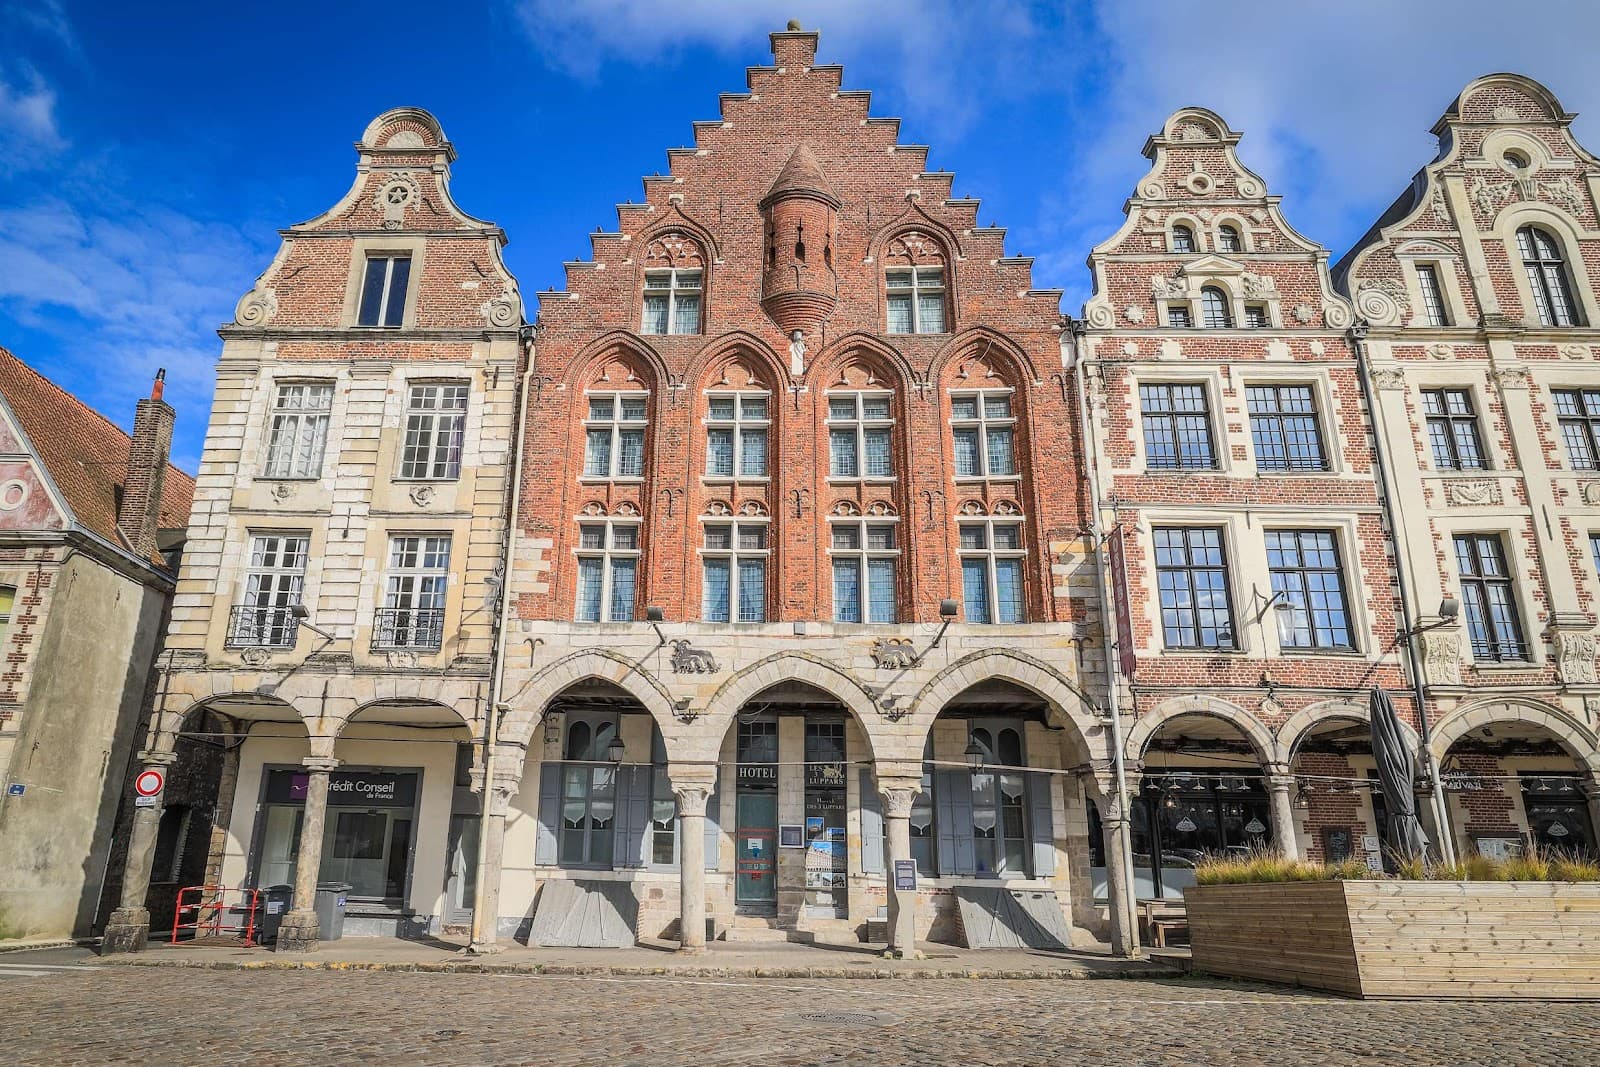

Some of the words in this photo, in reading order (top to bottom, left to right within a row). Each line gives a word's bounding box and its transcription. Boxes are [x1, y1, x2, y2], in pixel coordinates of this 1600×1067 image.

[739, 767, 776, 778] HOTEL
[327, 780, 353, 791] rédit
[355, 781, 395, 792] Conseil
